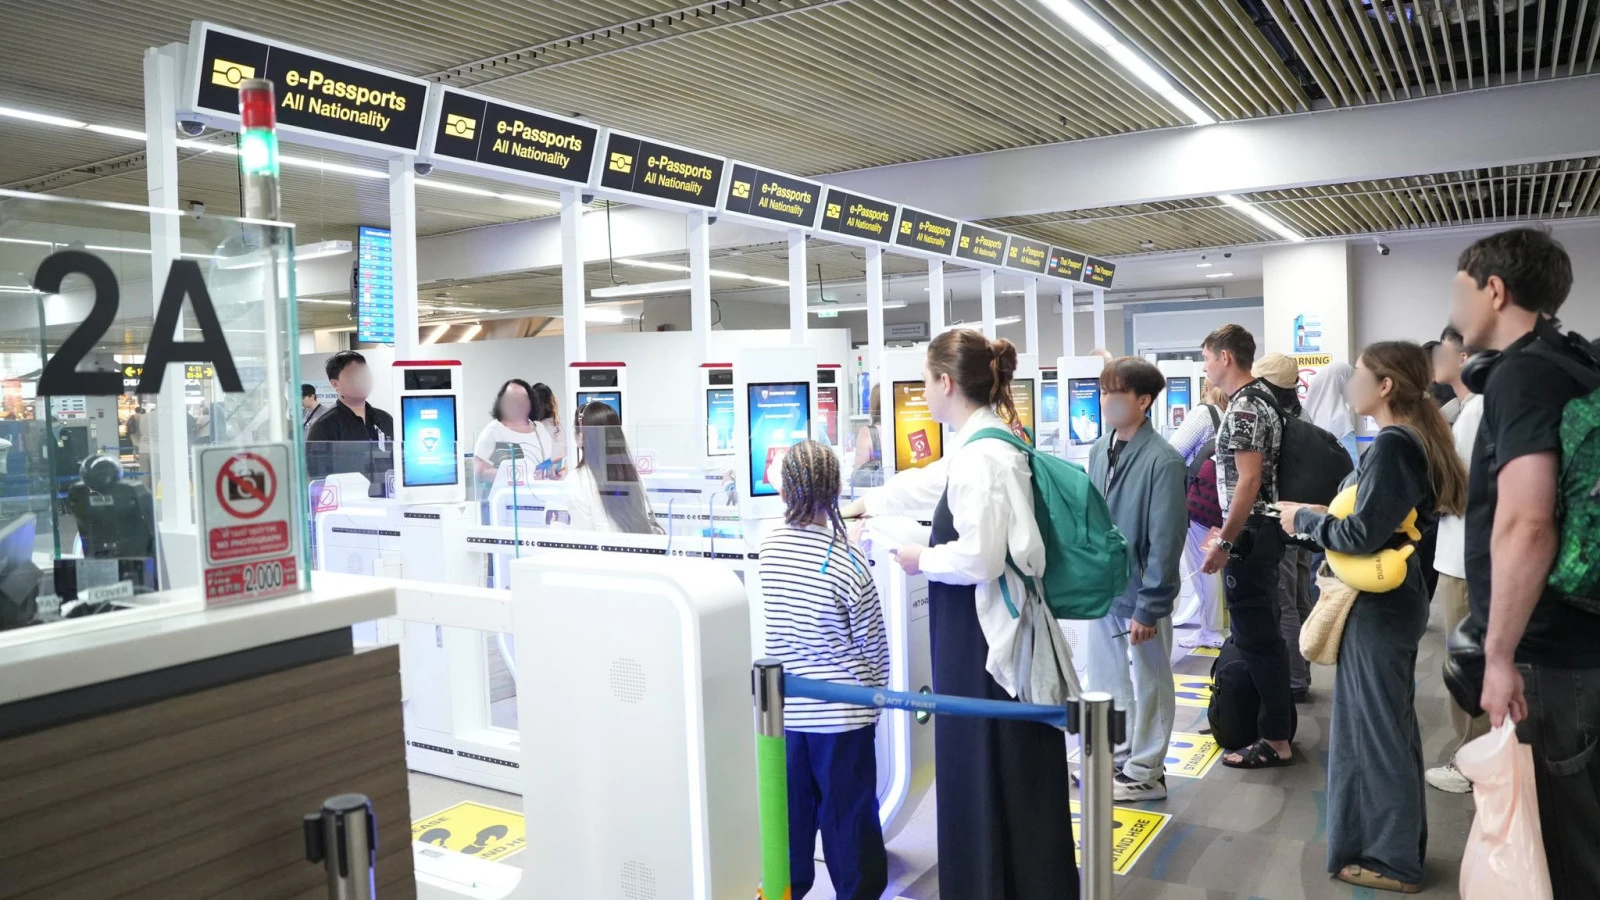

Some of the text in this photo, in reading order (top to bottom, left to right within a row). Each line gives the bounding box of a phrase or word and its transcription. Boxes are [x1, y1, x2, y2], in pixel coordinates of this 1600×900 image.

[285, 68, 406, 112] e-Passports
[281, 92, 391, 132] All Nationality
[497, 120, 583, 152] e-Passports
[492, 138, 571, 169] All Nationality
[648, 156, 712, 180] e-Passports
[644, 172, 703, 196] All Nationality
[761, 183, 811, 204] e-Passports
[758, 197, 804, 218] All Nationality
[850, 204, 889, 222] e-Passports
[846, 217, 882, 235] All Nationality
[919, 221, 951, 237] e-Passports
[923, 234, 946, 248] Nationality
[34, 250, 245, 395] 2A
[1294, 356, 1330, 365] RNING
[216, 535, 282, 549] NO PHOTOGRAPH
[1184, 753, 1205, 770] STAND
[1125, 819, 1150, 837] HERE
